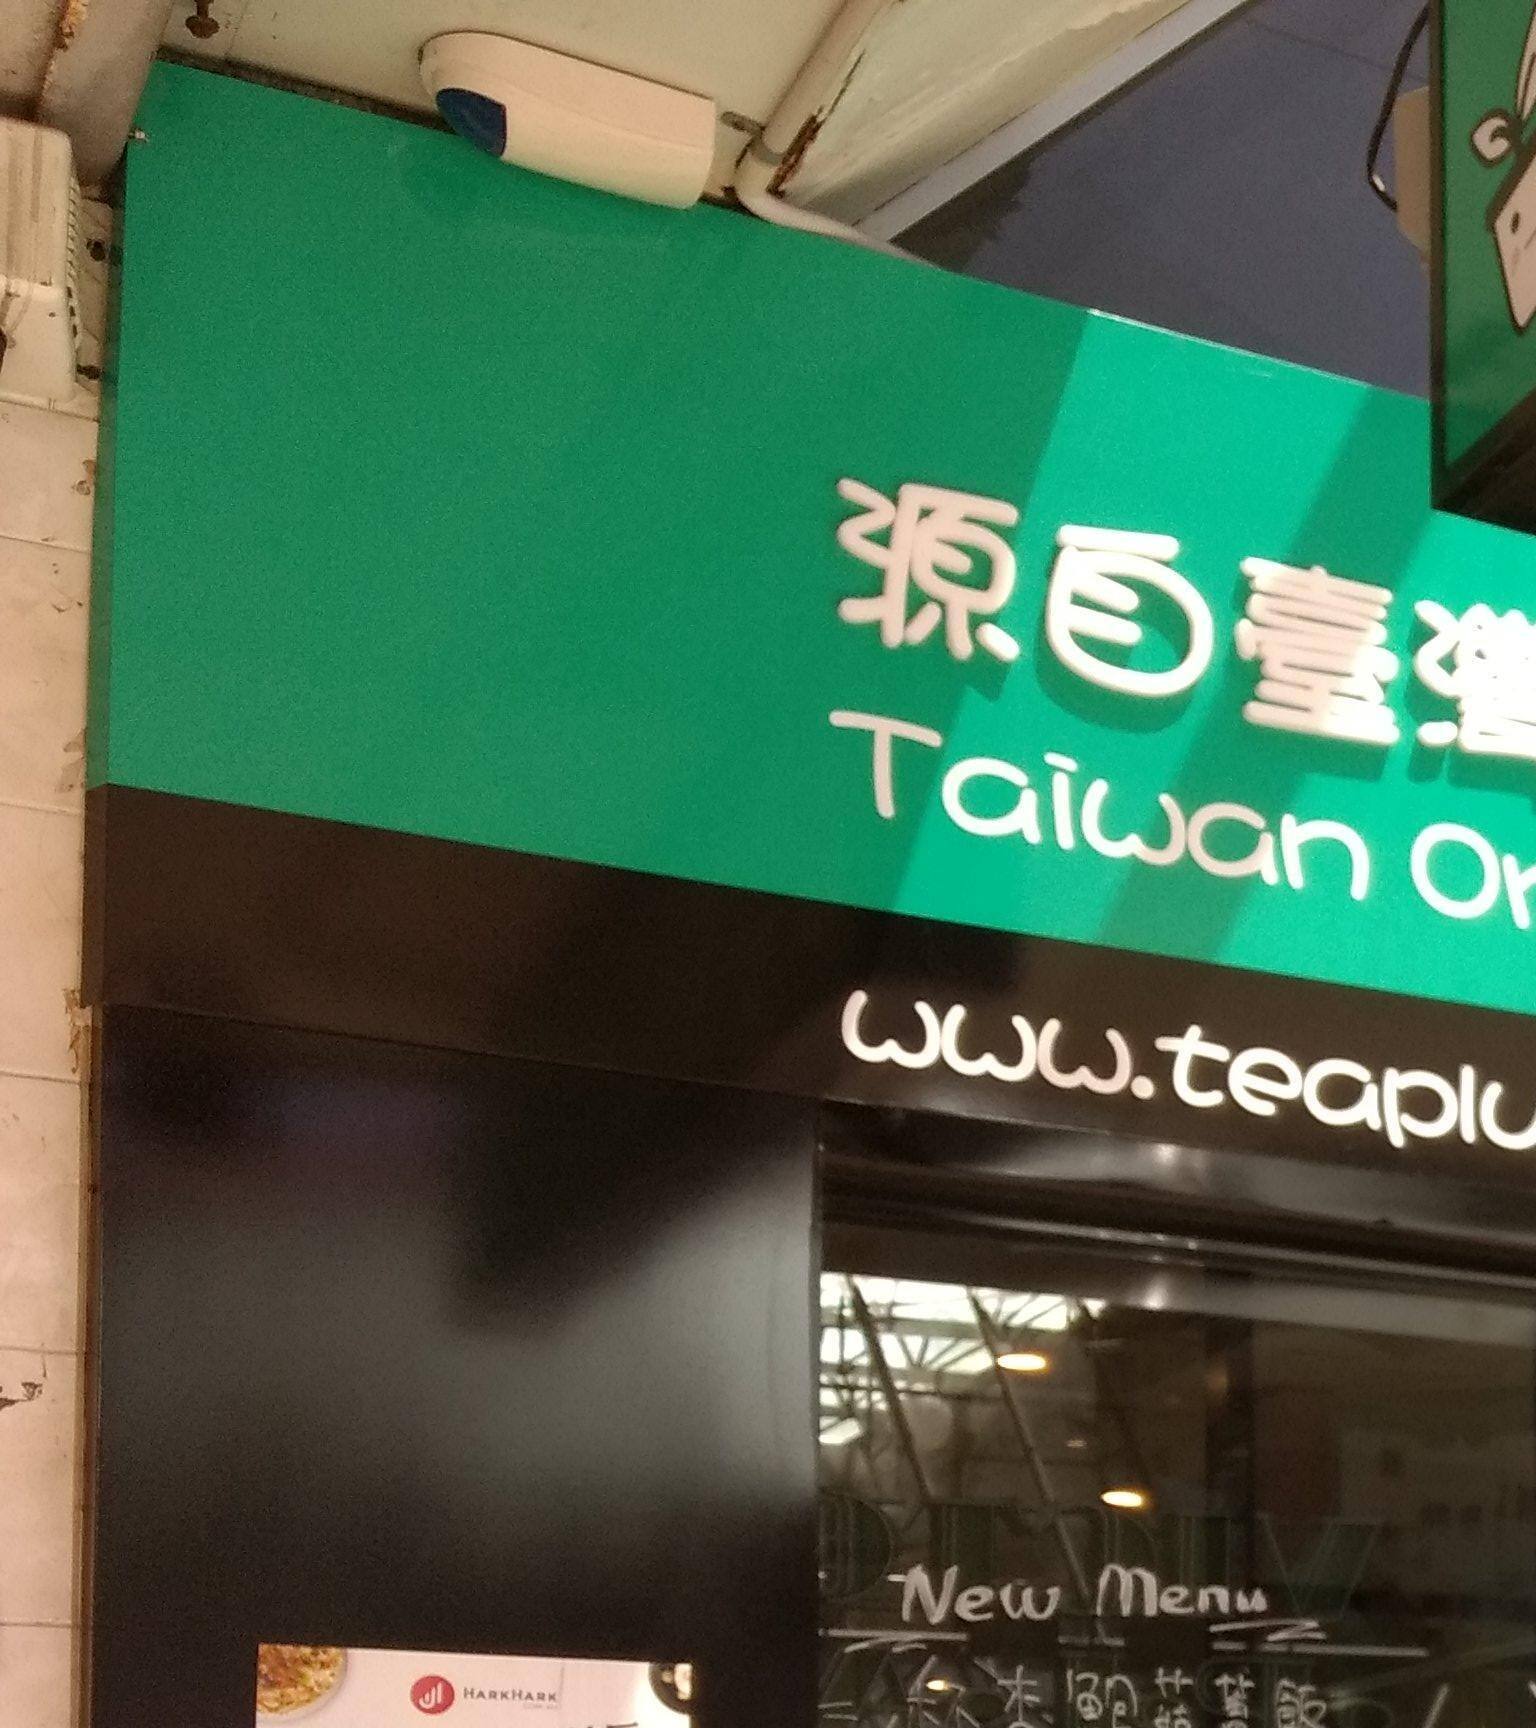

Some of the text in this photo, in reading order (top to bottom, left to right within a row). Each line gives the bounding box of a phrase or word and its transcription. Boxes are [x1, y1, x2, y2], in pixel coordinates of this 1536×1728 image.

[828, 709, 1370, 902] Taiwan
[892, 1564, 1268, 1623] New Menu
